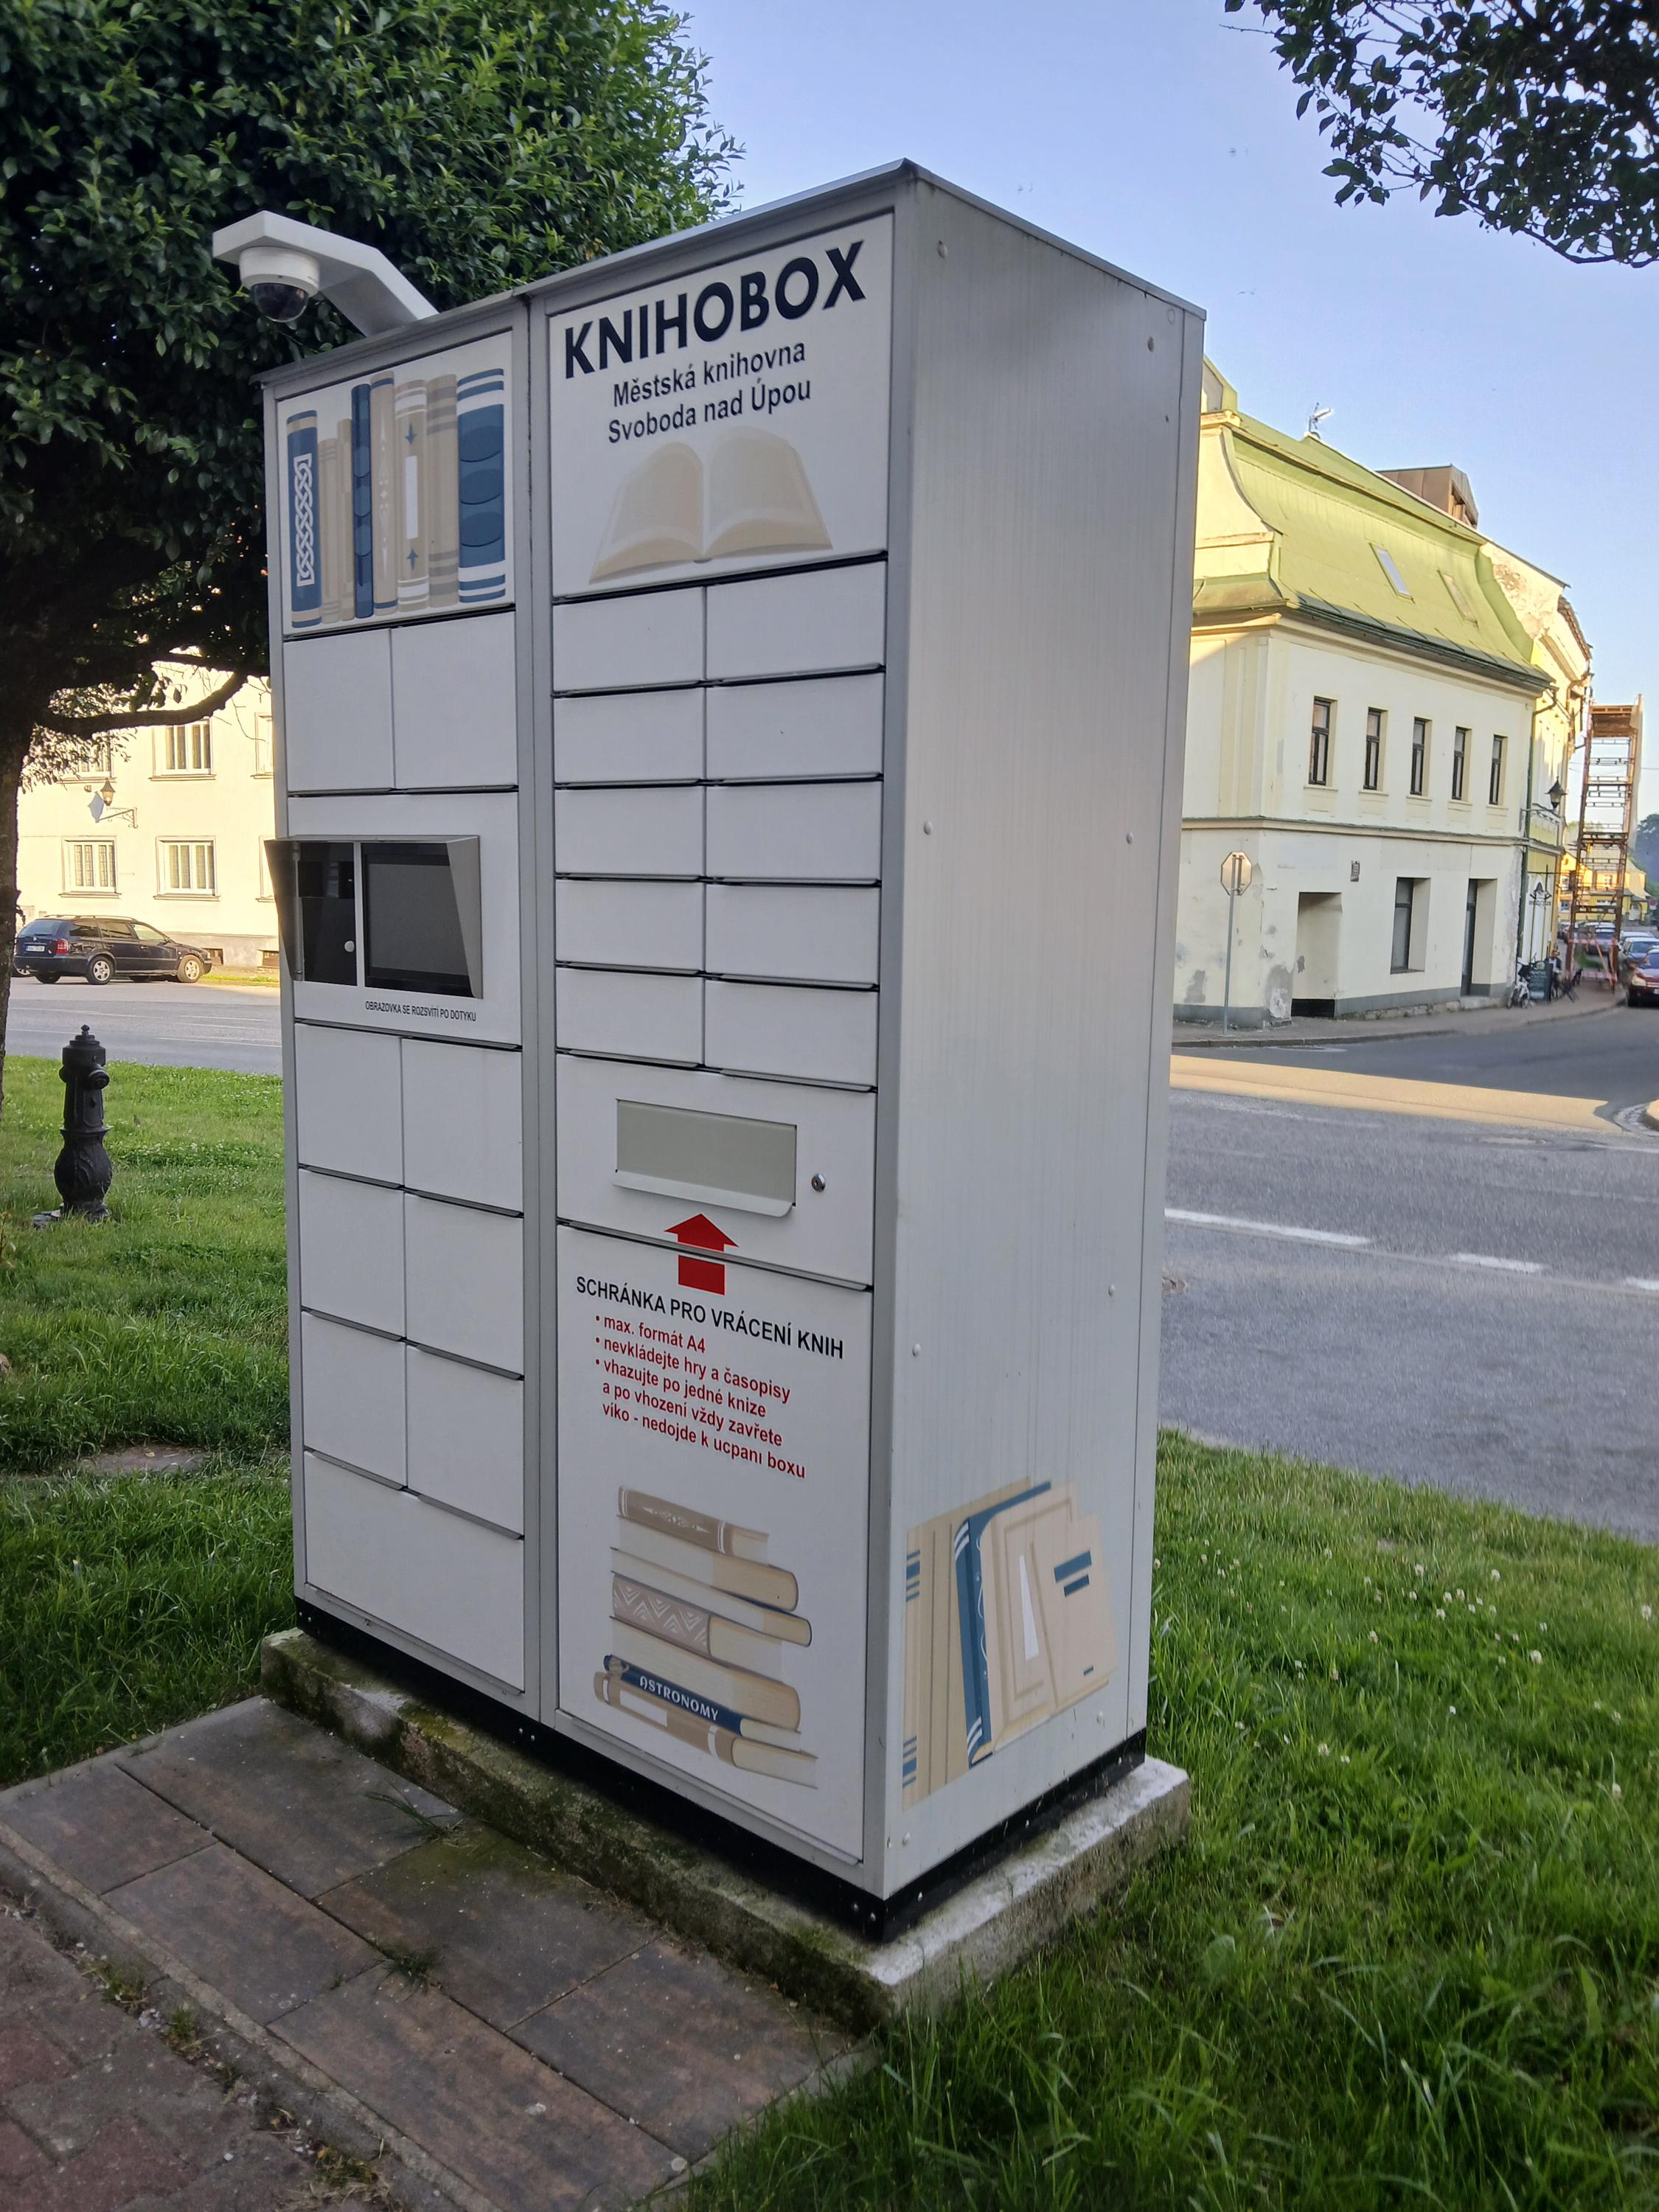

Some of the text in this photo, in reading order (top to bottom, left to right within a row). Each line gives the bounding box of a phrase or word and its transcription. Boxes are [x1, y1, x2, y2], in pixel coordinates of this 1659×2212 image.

[566, 240, 866, 379] KNIHOBOX
[614, 343, 806, 407] Městská knihovna
[608, 378, 811, 443] Svoboda nad Úpou
[365, 1001, 402, 1014] OBRAZOVKA
[403, 1004, 411, 1015] SE
[440, 1008, 449, 1019] PO
[451, 1009, 477, 1022] DOTYKU
[576, 1276, 844, 1360] SCHRÁNKA PRO VRÁCENÍ KNIH
[604, 1316, 706, 1354] max. formát A4
[603, 1360, 766, 1418] vhazujte po jedné knize
[604, 1338, 790, 1404] nevkládejte hry a časopisy
[602, 1382, 782, 1447] a po vhození vždy zavřete
[602, 1402, 629, 1422] víko
[642, 1416, 697, 1443] nedojde
[701, 1430, 709, 1447] k
[768, 1451, 805, 1478] boxu
[639, 1675, 718, 1722] ASTRONOMY
